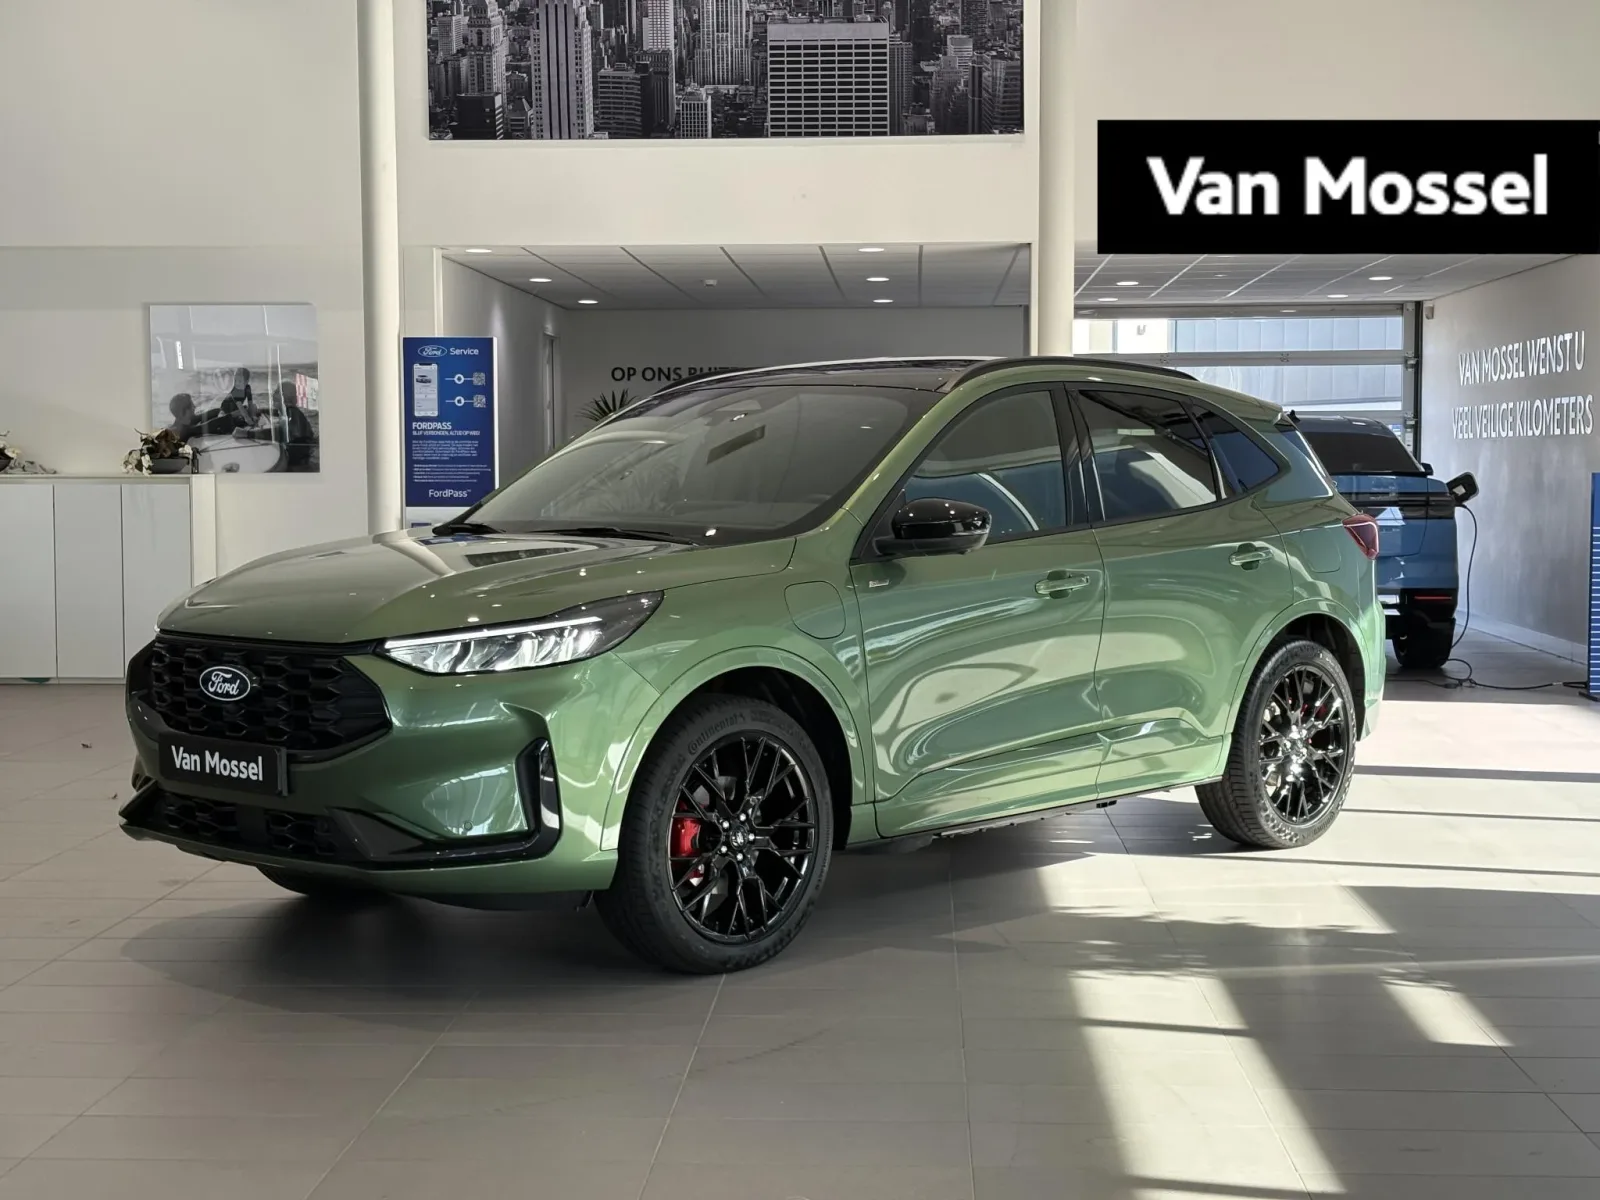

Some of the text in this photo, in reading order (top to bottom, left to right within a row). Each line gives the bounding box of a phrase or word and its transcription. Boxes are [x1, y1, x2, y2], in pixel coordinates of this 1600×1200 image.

[449, 347, 479, 356] Service
[1458, 330, 1585, 387] VAN MOSSEL WENST U
[611, 366, 637, 382] OP
[641, 366, 682, 382] ONS
[412, 421, 452, 430] FORDPASS
[1451, 394, 1593, 440] VEEL VEILIGE KILOMETERS
[208, 671, 240, 695] Ford
[687, 713, 741, 755] Continental
[171, 745, 264, 781] Van Mossel
